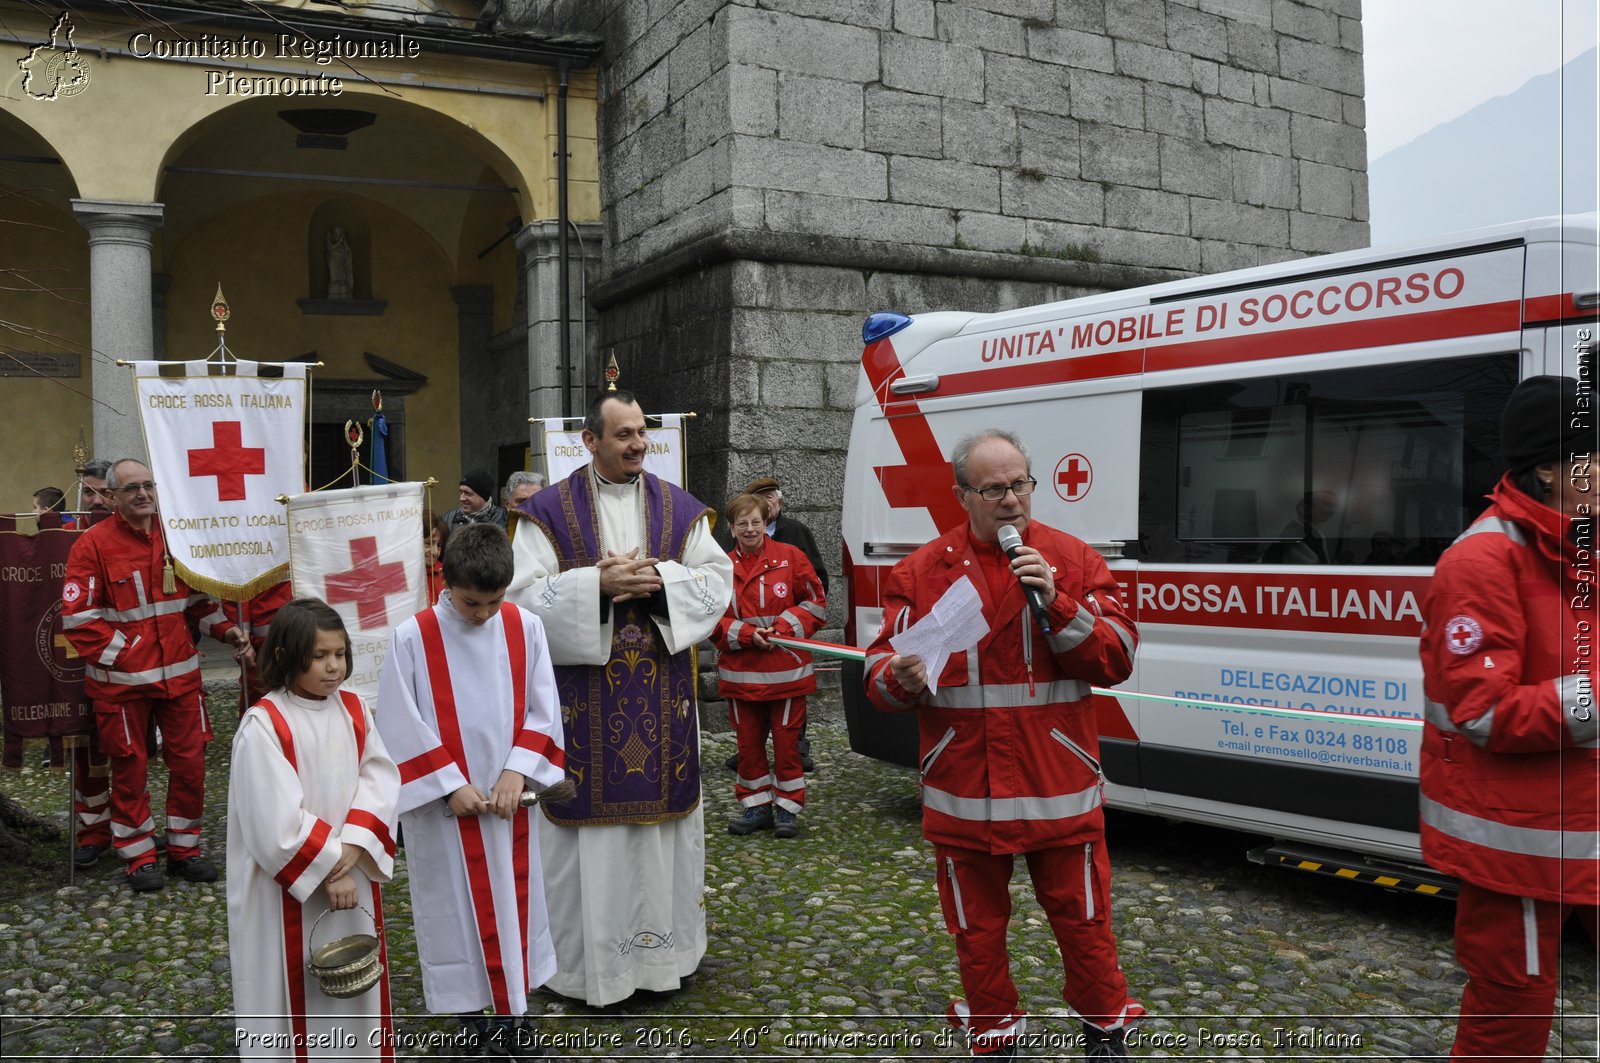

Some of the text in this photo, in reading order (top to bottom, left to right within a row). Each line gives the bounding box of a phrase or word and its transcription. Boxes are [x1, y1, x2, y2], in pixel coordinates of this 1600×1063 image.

[980, 267, 1466, 363] UNITA' MOBILE DI SOCCORSO
[150, 394, 292, 409] CROCE ROSSA ITALIANA
[554, 445, 583, 457] CROCE
[168, 516, 240, 530] COMITATO
[295, 506, 421, 533] CROCE ROSSA ITALIANA
[190, 541, 274, 559] DOMODOSSOLA
[2, 567, 43, 582] CROCE
[1138, 583, 1247, 614] ROSSA
[1256, 586, 1424, 622] ITALIANA
[1221, 669, 1407, 701] DELEGAZIONE DI
[11, 703, 71, 721] DELEGAZIONE
[1221, 720, 1407, 755] Tel. e Fax 0324 88108
[1218, 739, 1413, 772] e-mail premosello@criverbania.it
